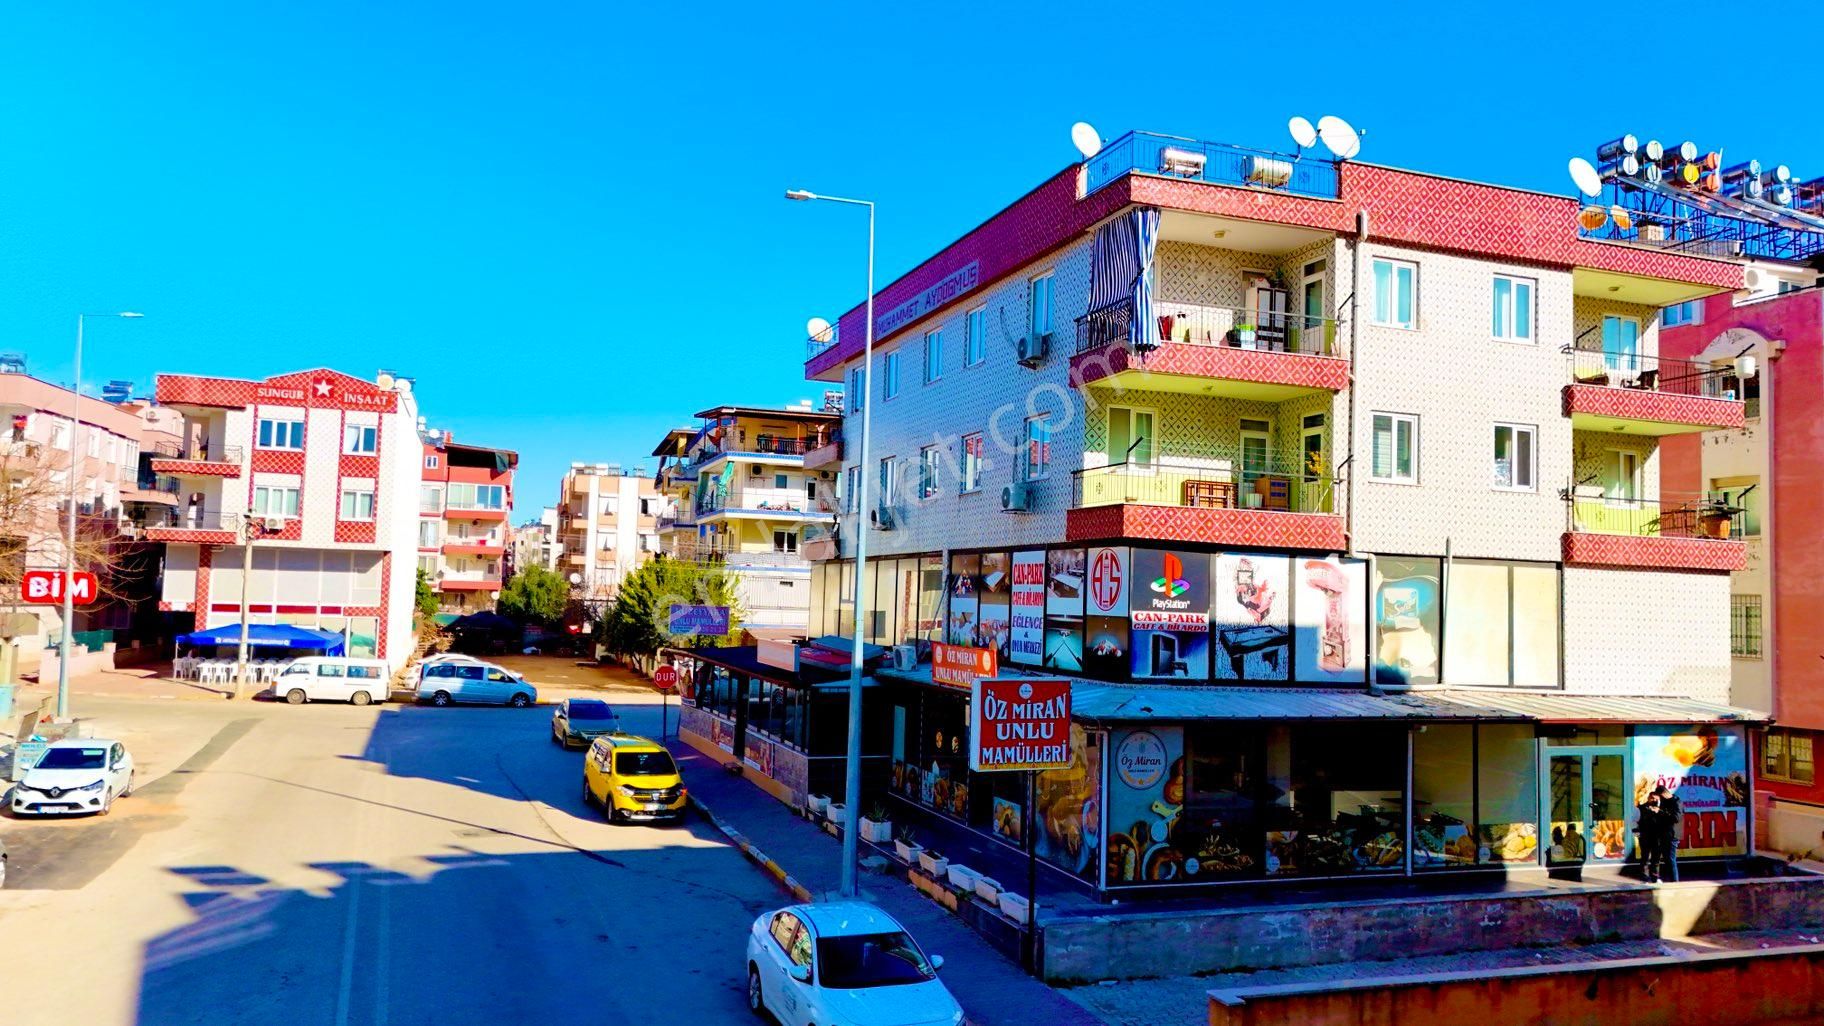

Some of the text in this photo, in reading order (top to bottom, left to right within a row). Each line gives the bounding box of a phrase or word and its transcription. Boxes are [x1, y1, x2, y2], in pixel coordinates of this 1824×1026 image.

[257, 387, 388, 406] SUNGUR İNŞAAT
[1013, 563, 1044, 586] CAN-PARK
[29, 573, 89, 598] BİM
[1152, 599, 1187, 610] PlayStation
[1012, 613, 1043, 629] EĞLENCE
[1134, 612, 1206, 624] CAN-PARK
[1167, 623, 1207, 632] BİLARDO
[946, 648, 978, 666] ÖZ MİRAN
[656, 672, 675, 682] DUR
[935, 667, 952, 681] UNLU
[984, 689, 1067, 721] ÖZ MİRAN
[996, 722, 1055, 740] UNLU
[982, 739, 1067, 765] MAMÜLLERİ
[1121, 753, 1161, 770] Öz Miran
[1656, 774, 1730, 790] ÖZ MİRAN
